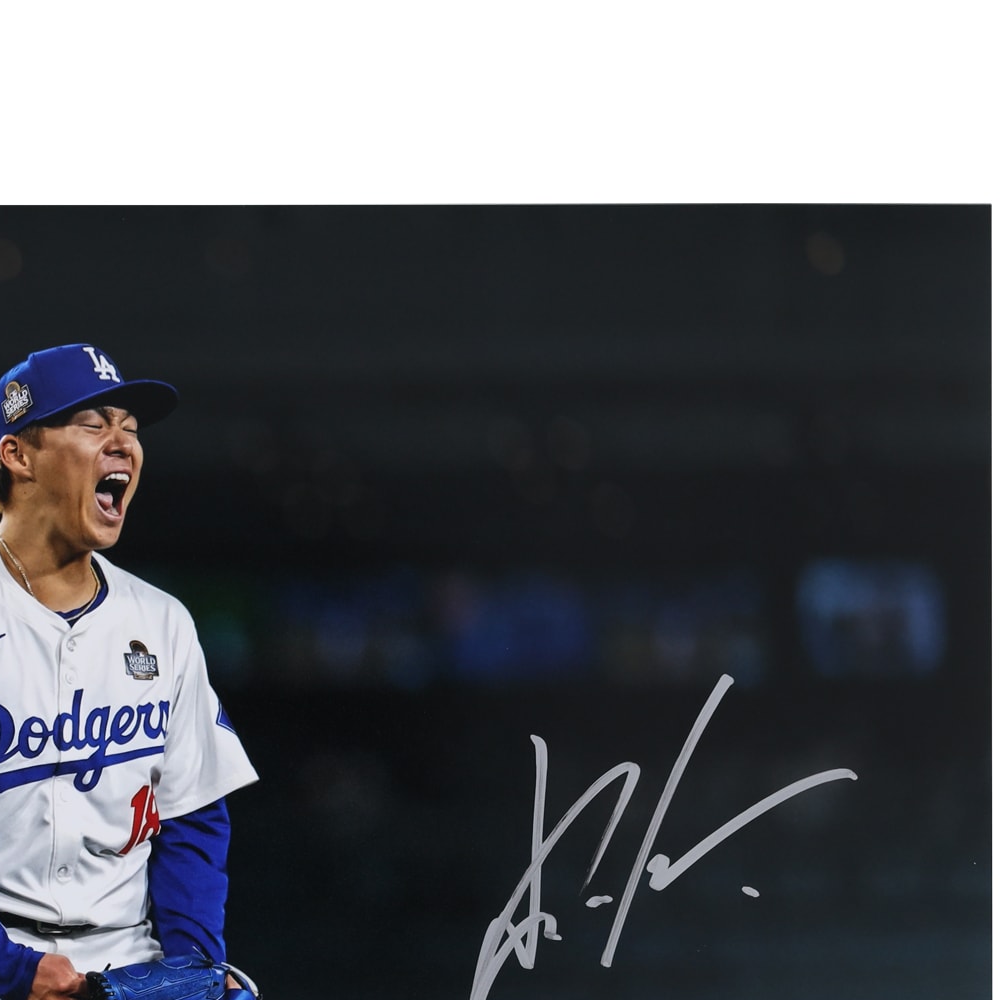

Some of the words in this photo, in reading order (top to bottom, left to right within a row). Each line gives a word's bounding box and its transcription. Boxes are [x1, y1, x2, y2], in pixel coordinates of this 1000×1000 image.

[83, 346, 120, 383] LA
[127, 655, 156, 665] WORLD
[129, 663, 156, 672] SERIES
